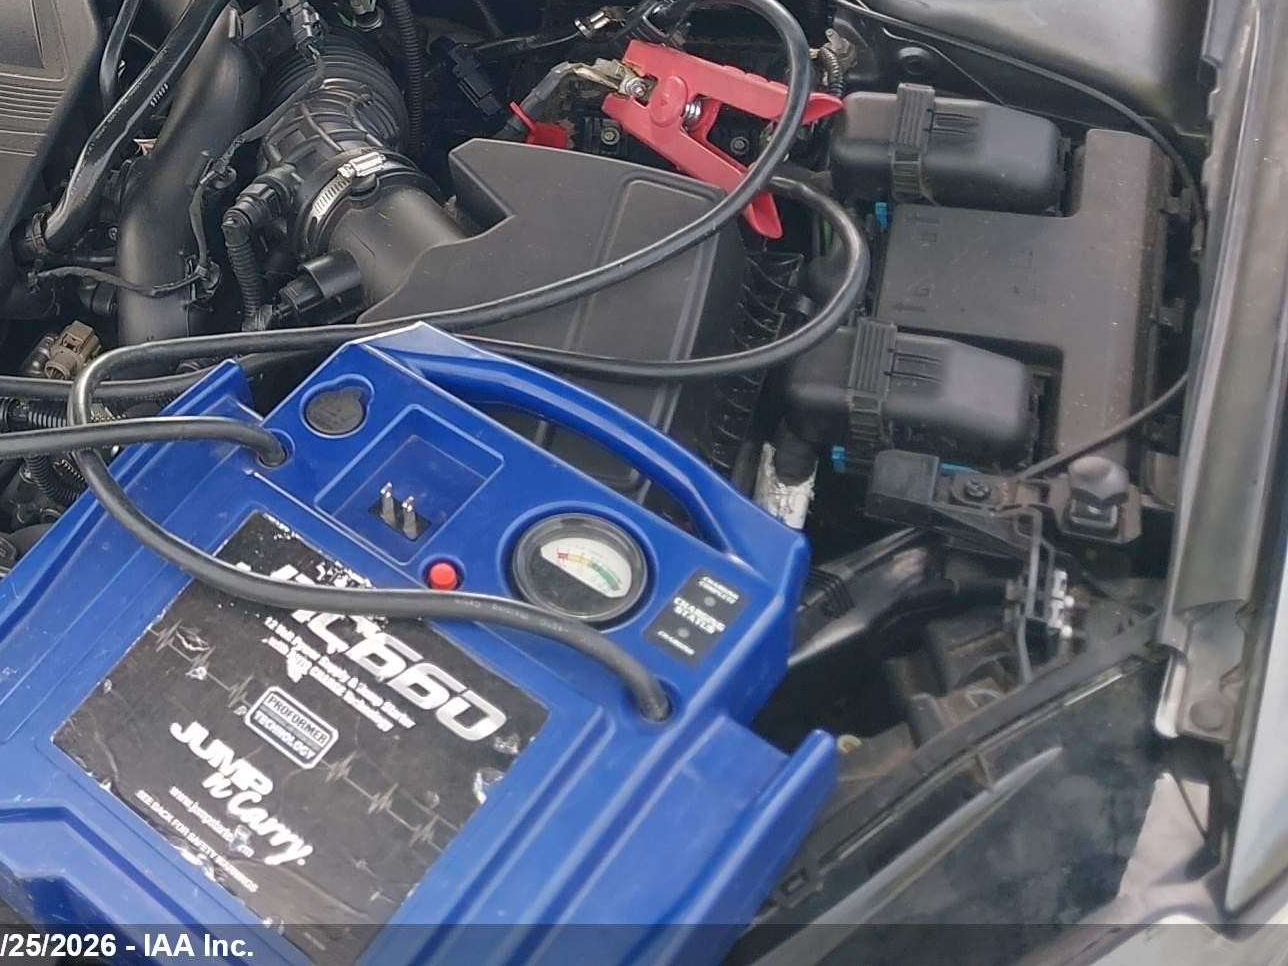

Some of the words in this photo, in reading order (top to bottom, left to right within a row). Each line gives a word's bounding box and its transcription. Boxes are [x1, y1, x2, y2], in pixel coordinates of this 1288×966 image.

[673, 605, 716, 634] STATUS
[267, 696, 327, 745] PROFORMER
[341, 690, 394, 734] Technology
[380, 701, 414, 730] Starter
[254, 709, 316, 760] TECHNOLOGY
[169, 721, 274, 796] JUMP
[171, 818, 190, 836] FOR
[186, 831, 218, 860] SAFETY
